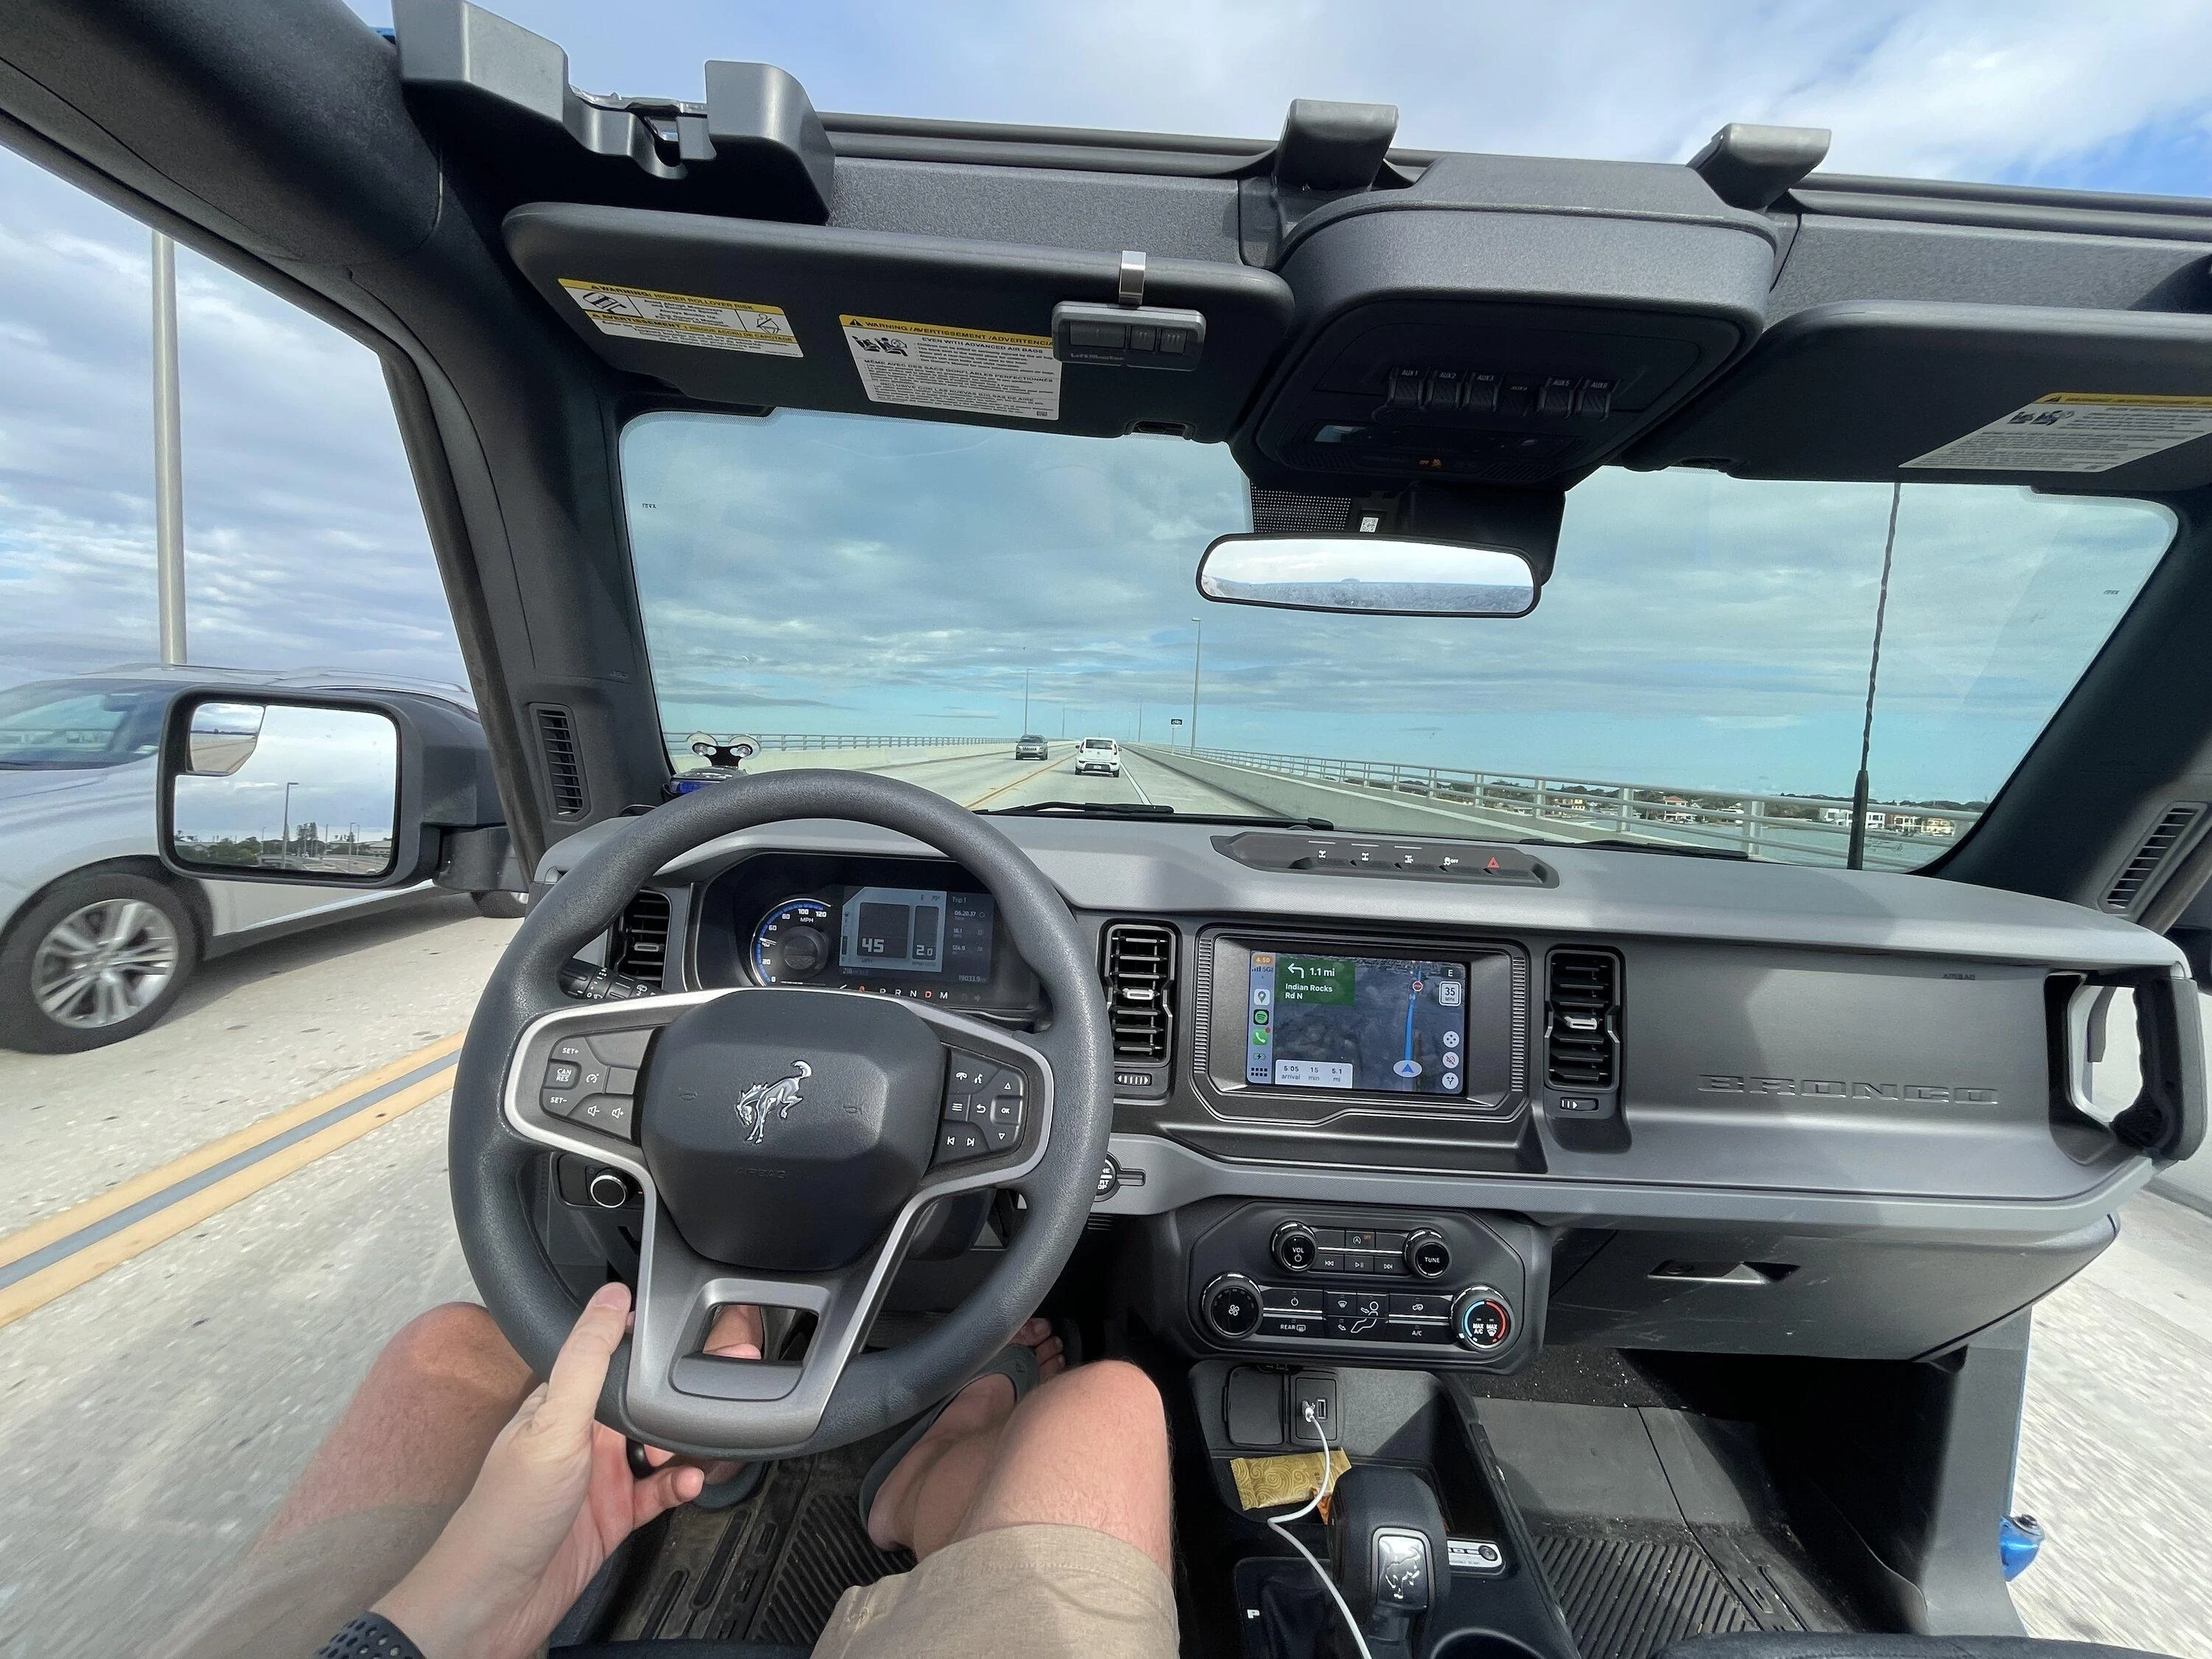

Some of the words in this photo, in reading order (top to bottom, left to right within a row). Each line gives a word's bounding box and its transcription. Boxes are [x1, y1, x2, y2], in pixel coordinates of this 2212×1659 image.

[653, 293, 686, 301] HIGHER
[686, 297, 733, 307] ROLLOVER
[600, 314, 680, 327] AVERTISSEMENT
[864, 321, 908, 331] WARNING
[964, 341, 1006, 349] ADVANCED
[861, 937, 885, 953] 45
[1310, 967, 1321, 976] 1.1
[1324, 968, 1335, 977] mi
[1447, 969, 1453, 977] E
[1285, 983, 1309, 991] Indian
[1310, 984, 1333, 992] Rocks
[1444, 987, 1455, 996] 35
[910, 990, 917, 998] N
[925, 990, 933, 998] D
[939, 991, 948, 1000] M
[1697, 1073, 1999, 1105] BRONCO
[1247, 1609, 1261, 1620] P
